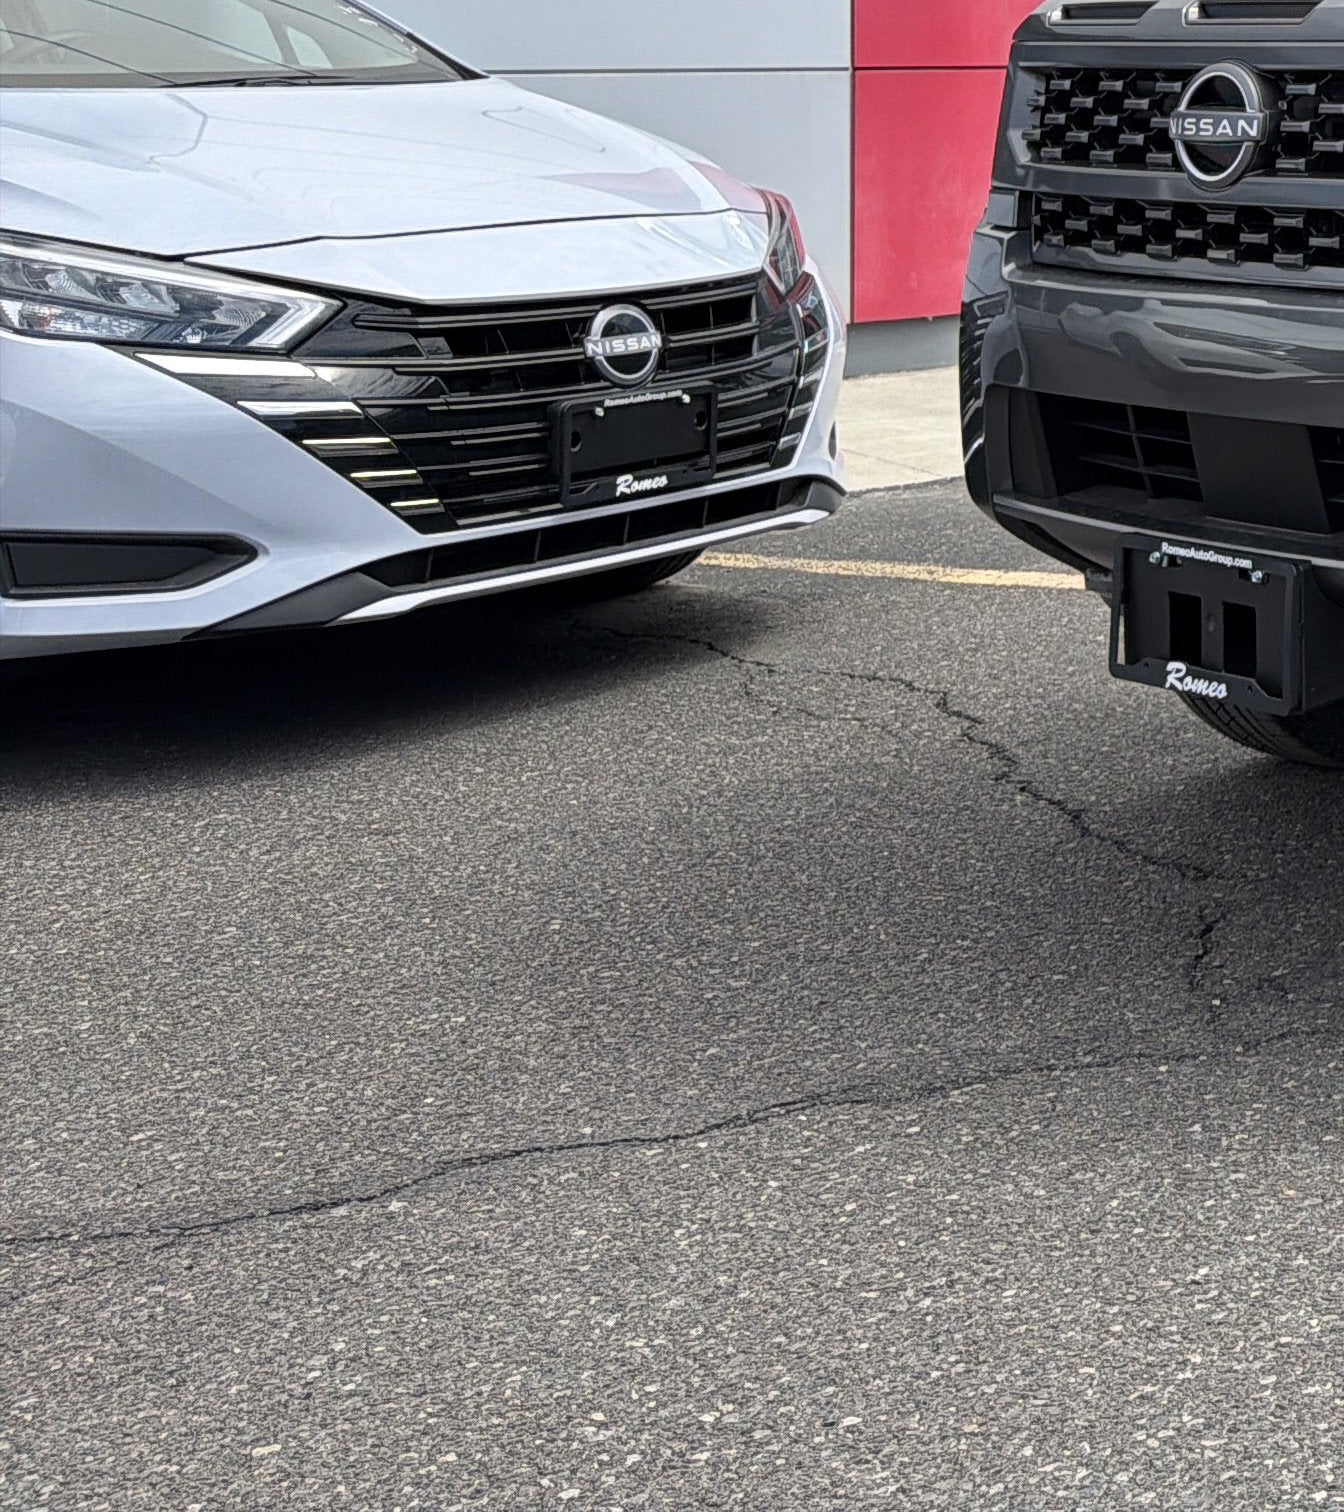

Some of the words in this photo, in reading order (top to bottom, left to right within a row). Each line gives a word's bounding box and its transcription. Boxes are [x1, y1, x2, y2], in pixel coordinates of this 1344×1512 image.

[1169, 117, 1258, 137] NISSAN
[587, 334, 662, 357] NISSAN
[604, 389, 683, 407] RomeoAutoGroup.com
[615, 473, 668, 497] Romeo
[1161, 541, 1252, 569] RomeoAutoGroup.com
[1165, 661, 1228, 698] Romeo
